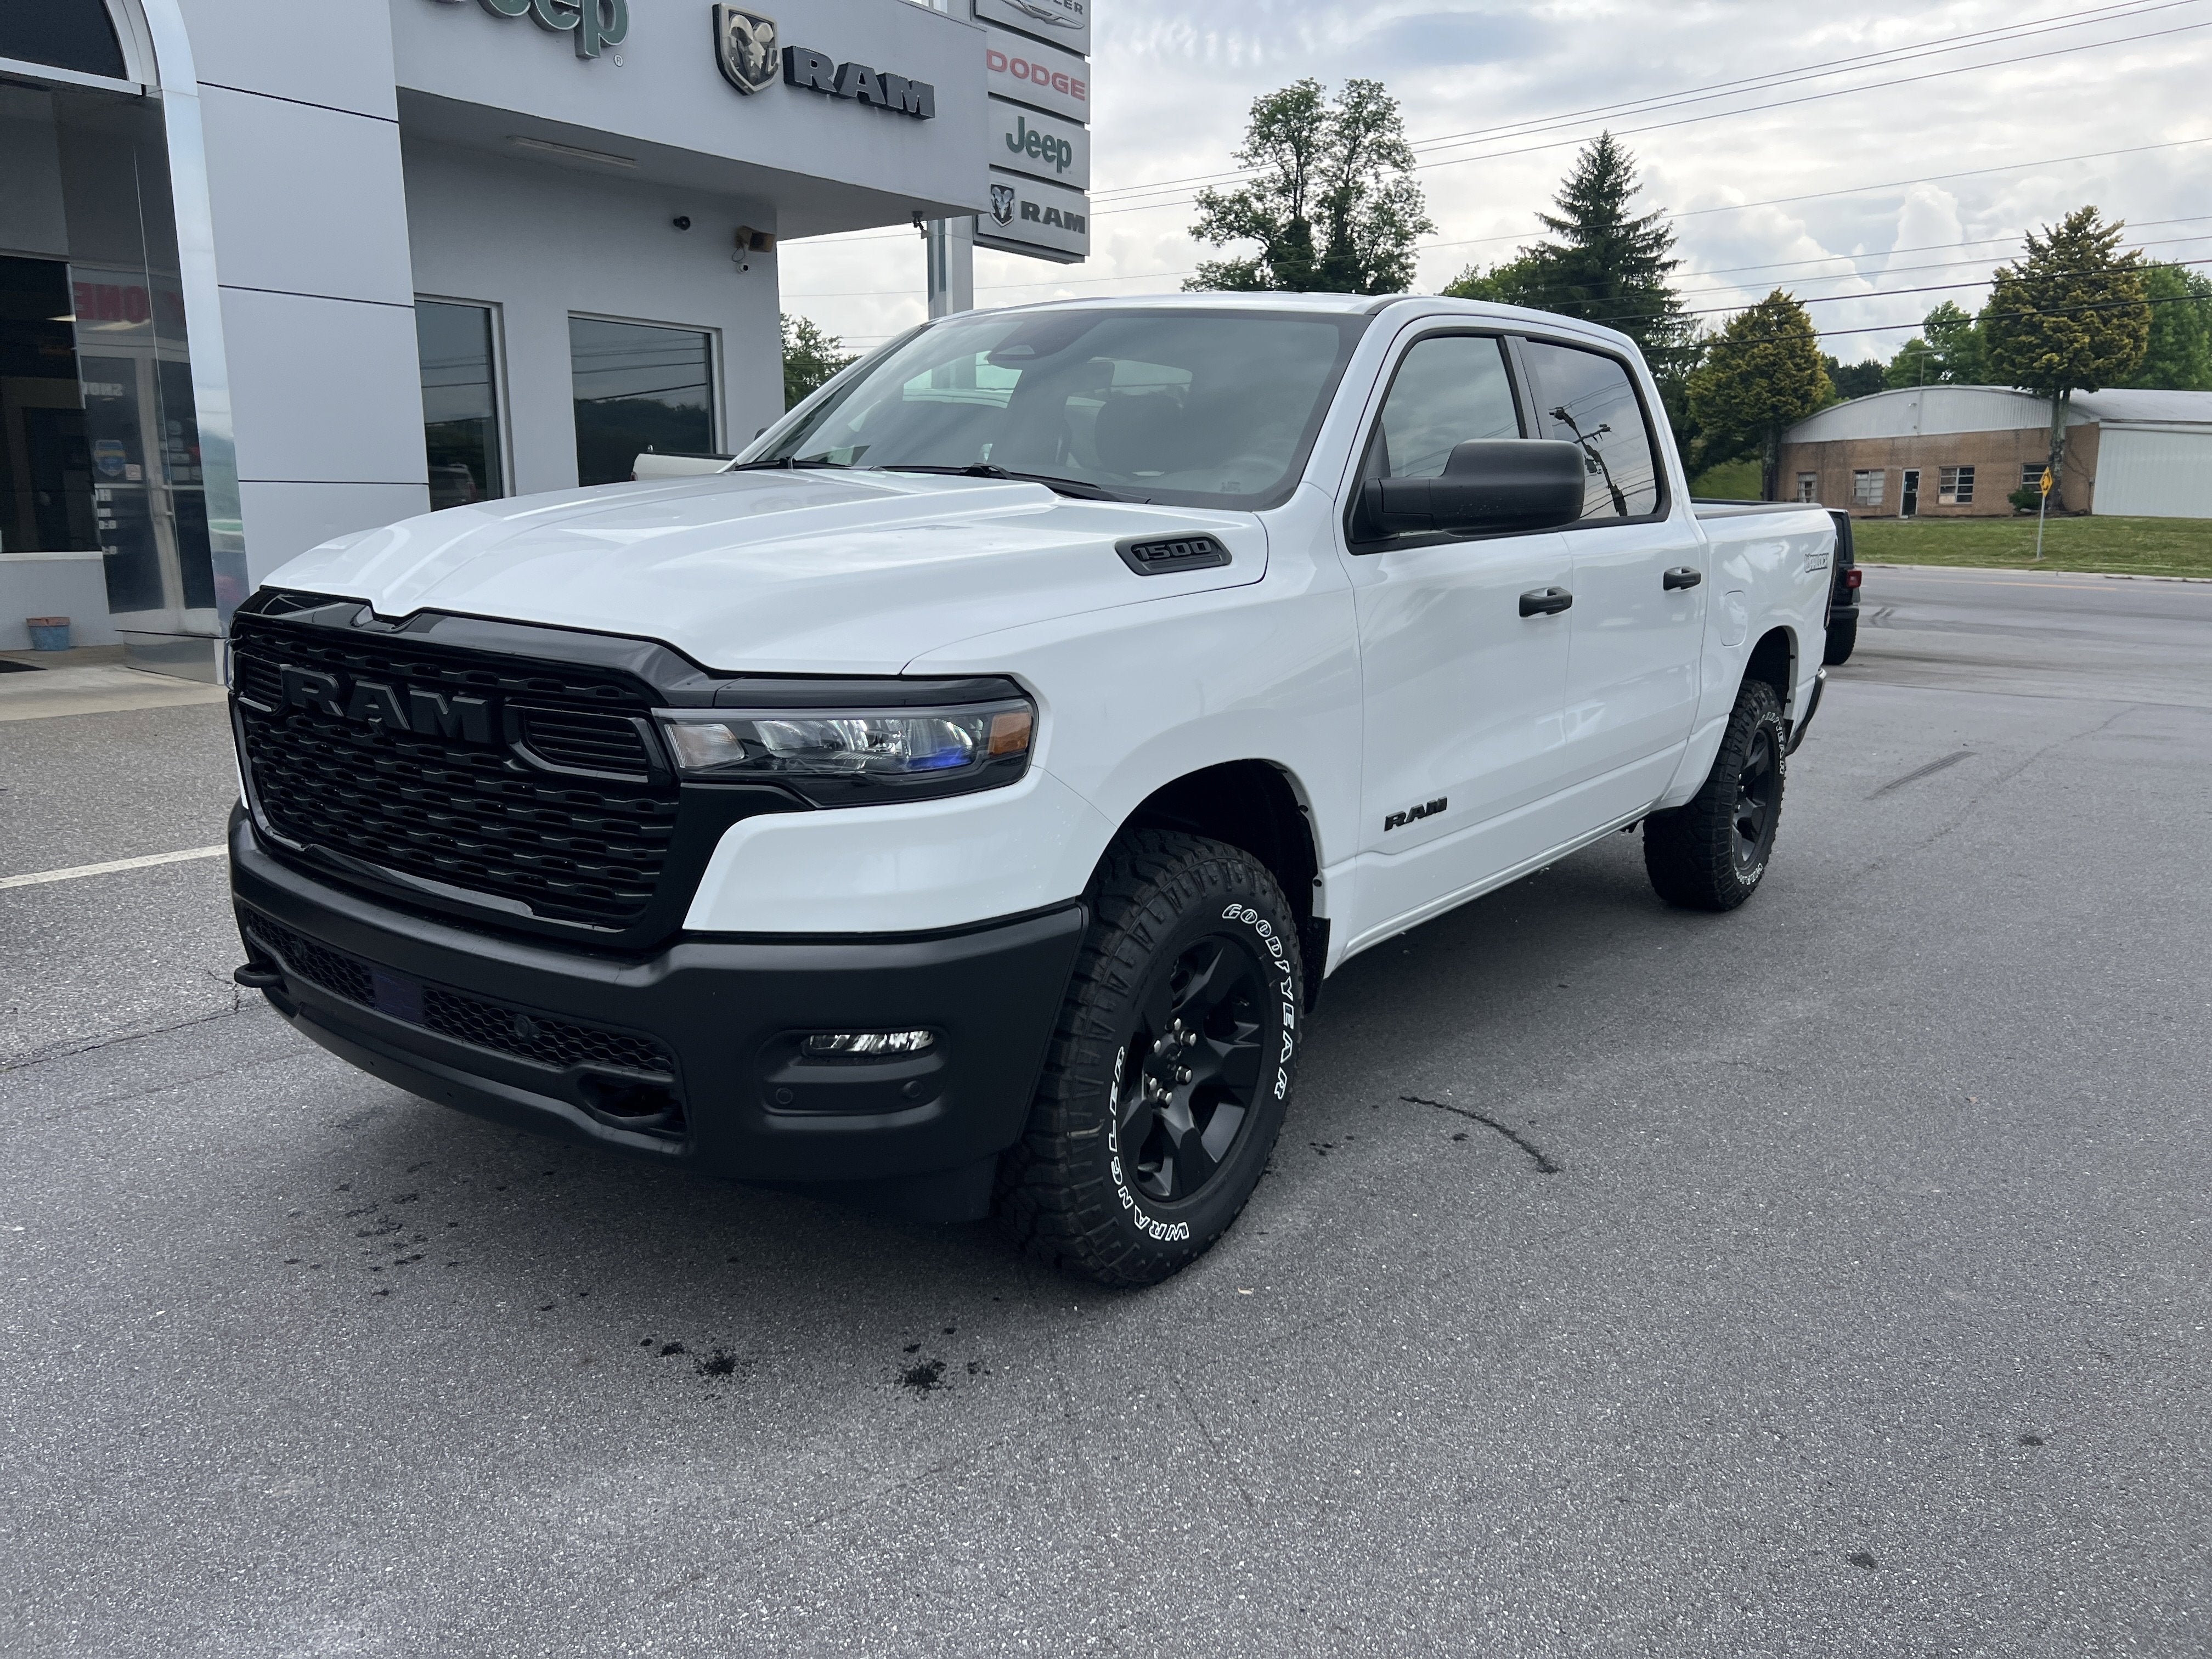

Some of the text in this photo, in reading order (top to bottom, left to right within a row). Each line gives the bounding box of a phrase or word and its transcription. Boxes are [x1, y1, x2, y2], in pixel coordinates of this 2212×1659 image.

[782, 46, 935, 120] RAM
[986, 49, 1085, 101] DODGE
[1006, 116, 1072, 173] Jeep
[1020, 200, 1085, 234] RAM
[1133, 540, 1212, 561] 1500
[280, 664, 490, 743] RAM
[1384, 796, 1447, 832] RAM
[1222, 903, 1294, 1101] GOODYEAR
[1109, 1046, 1189, 1242] WRANGLER
